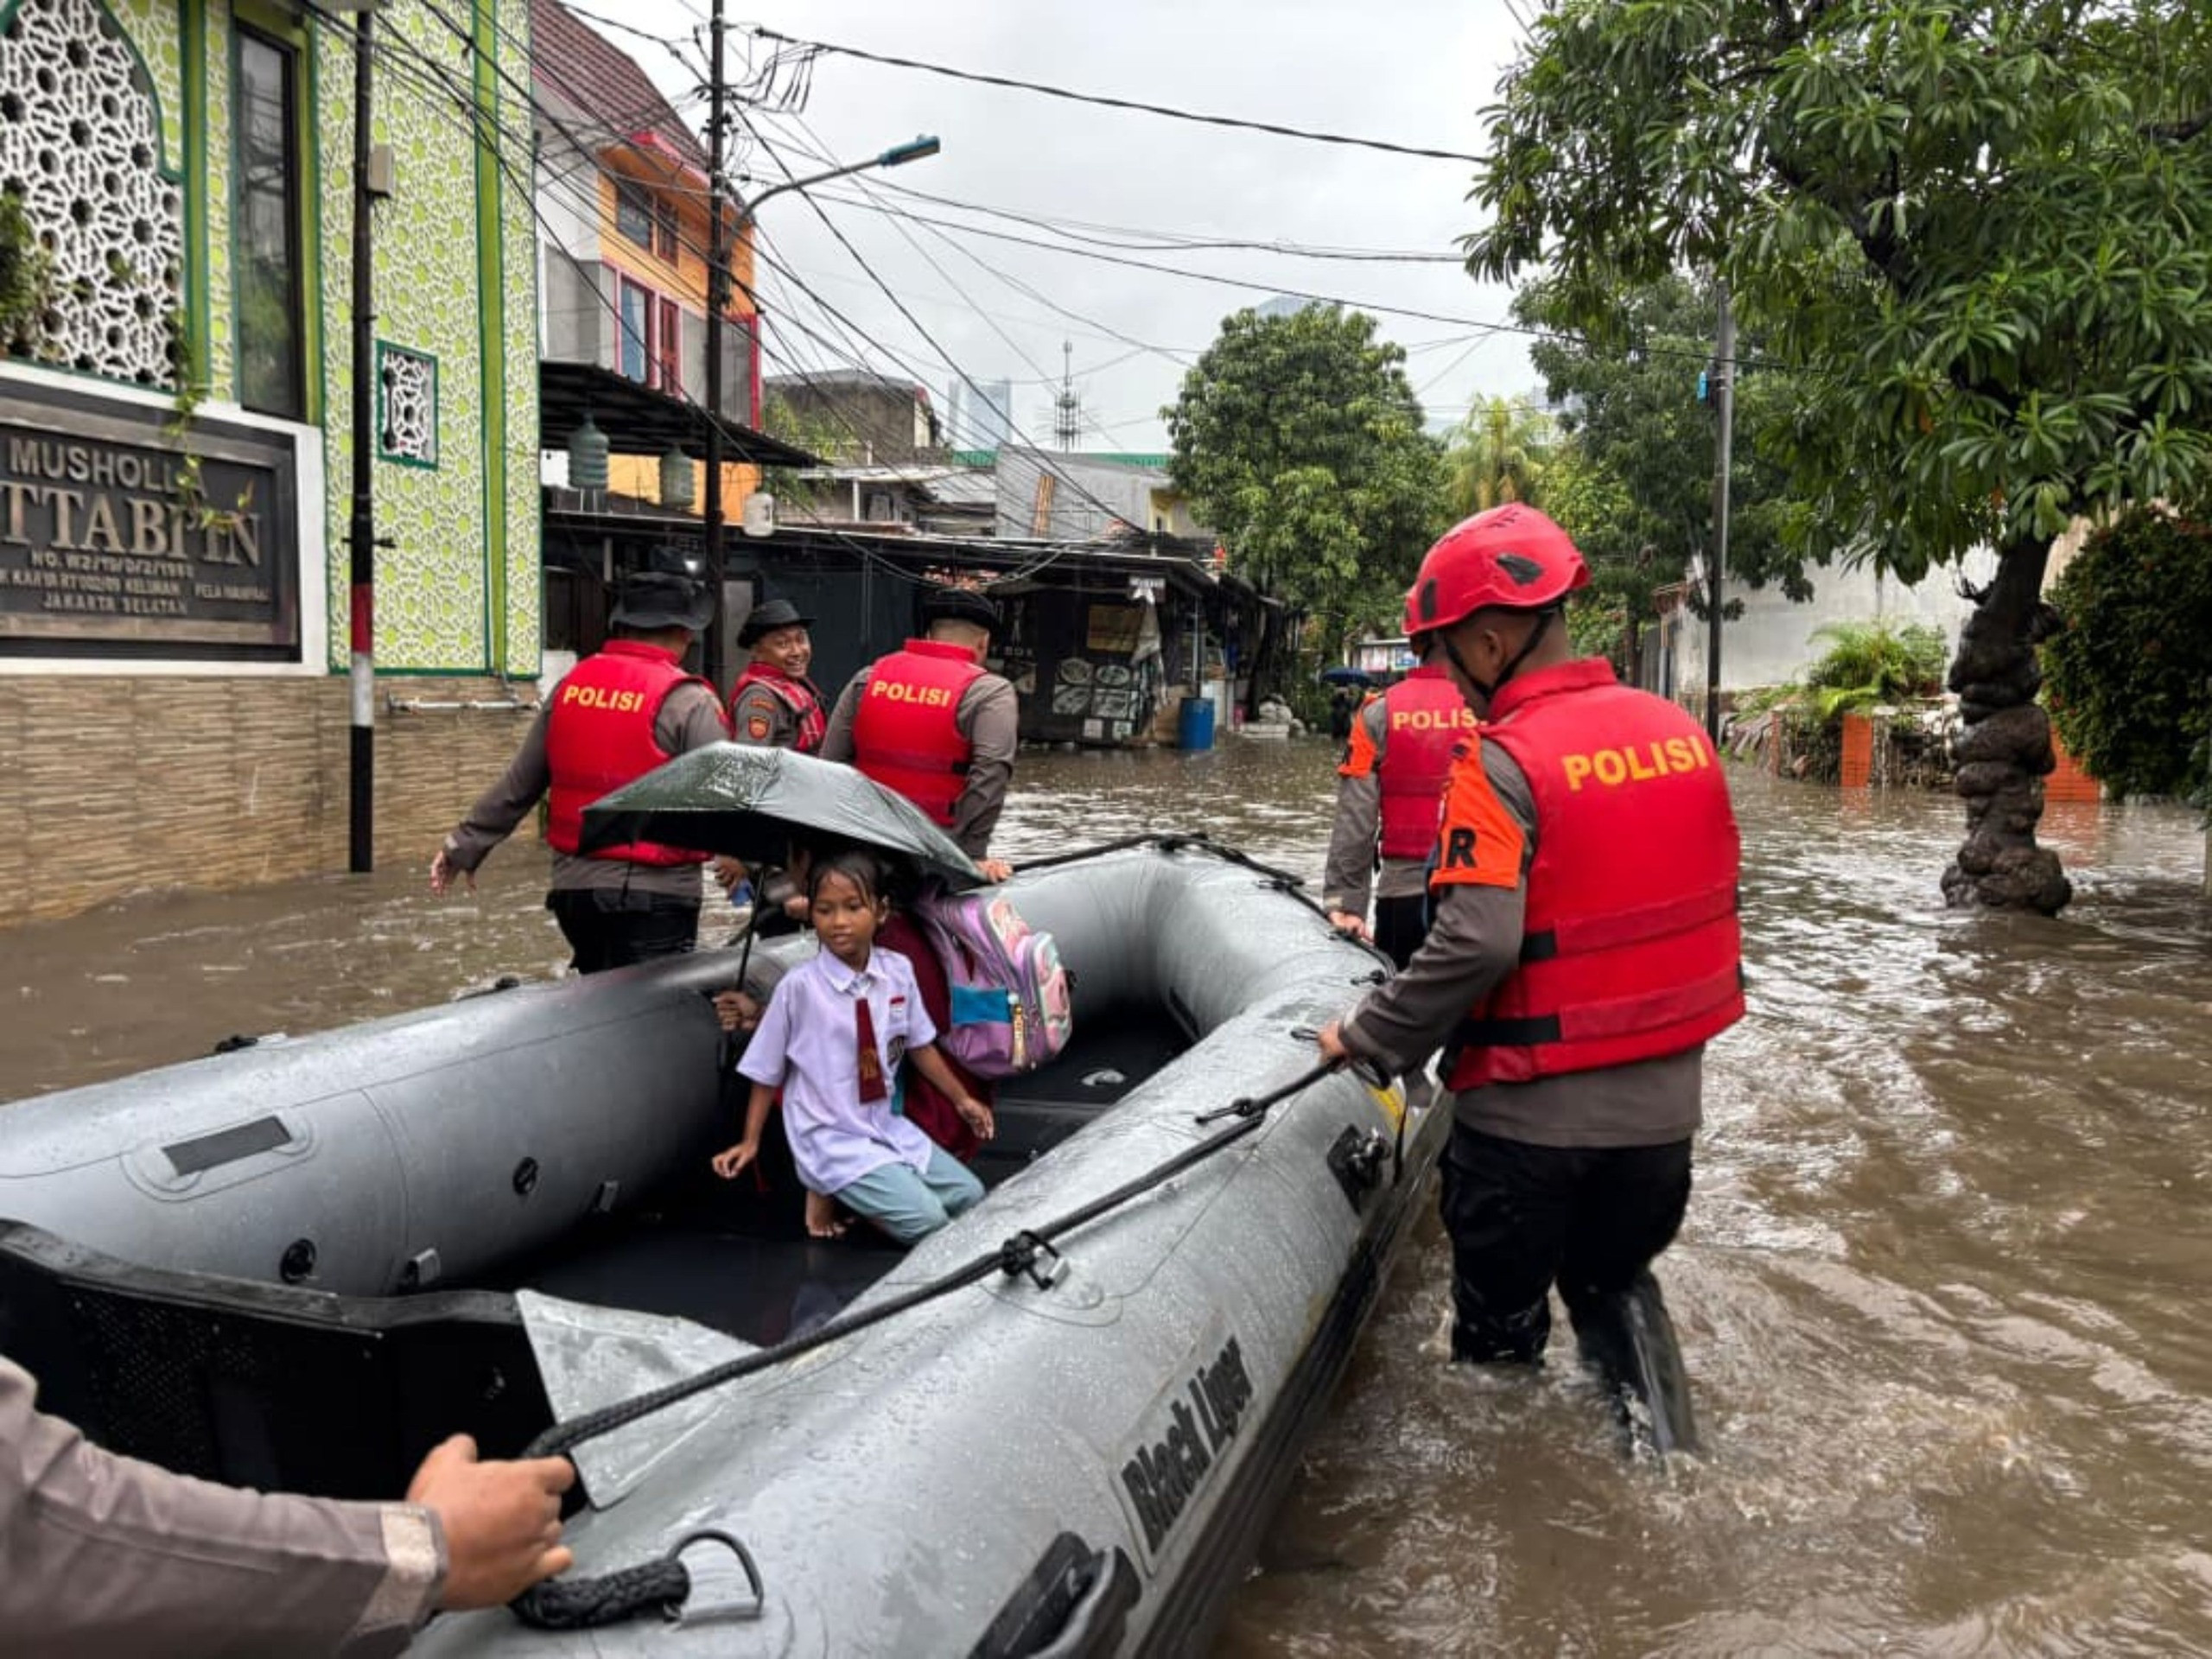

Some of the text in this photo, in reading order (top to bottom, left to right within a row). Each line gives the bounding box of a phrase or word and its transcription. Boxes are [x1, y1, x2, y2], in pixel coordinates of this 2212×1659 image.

[563, 683, 645, 713] POLISI
[871, 679, 952, 708] POLISI
[1392, 708, 1488, 730] POLIS
[1561, 734, 1709, 791] POLISI
